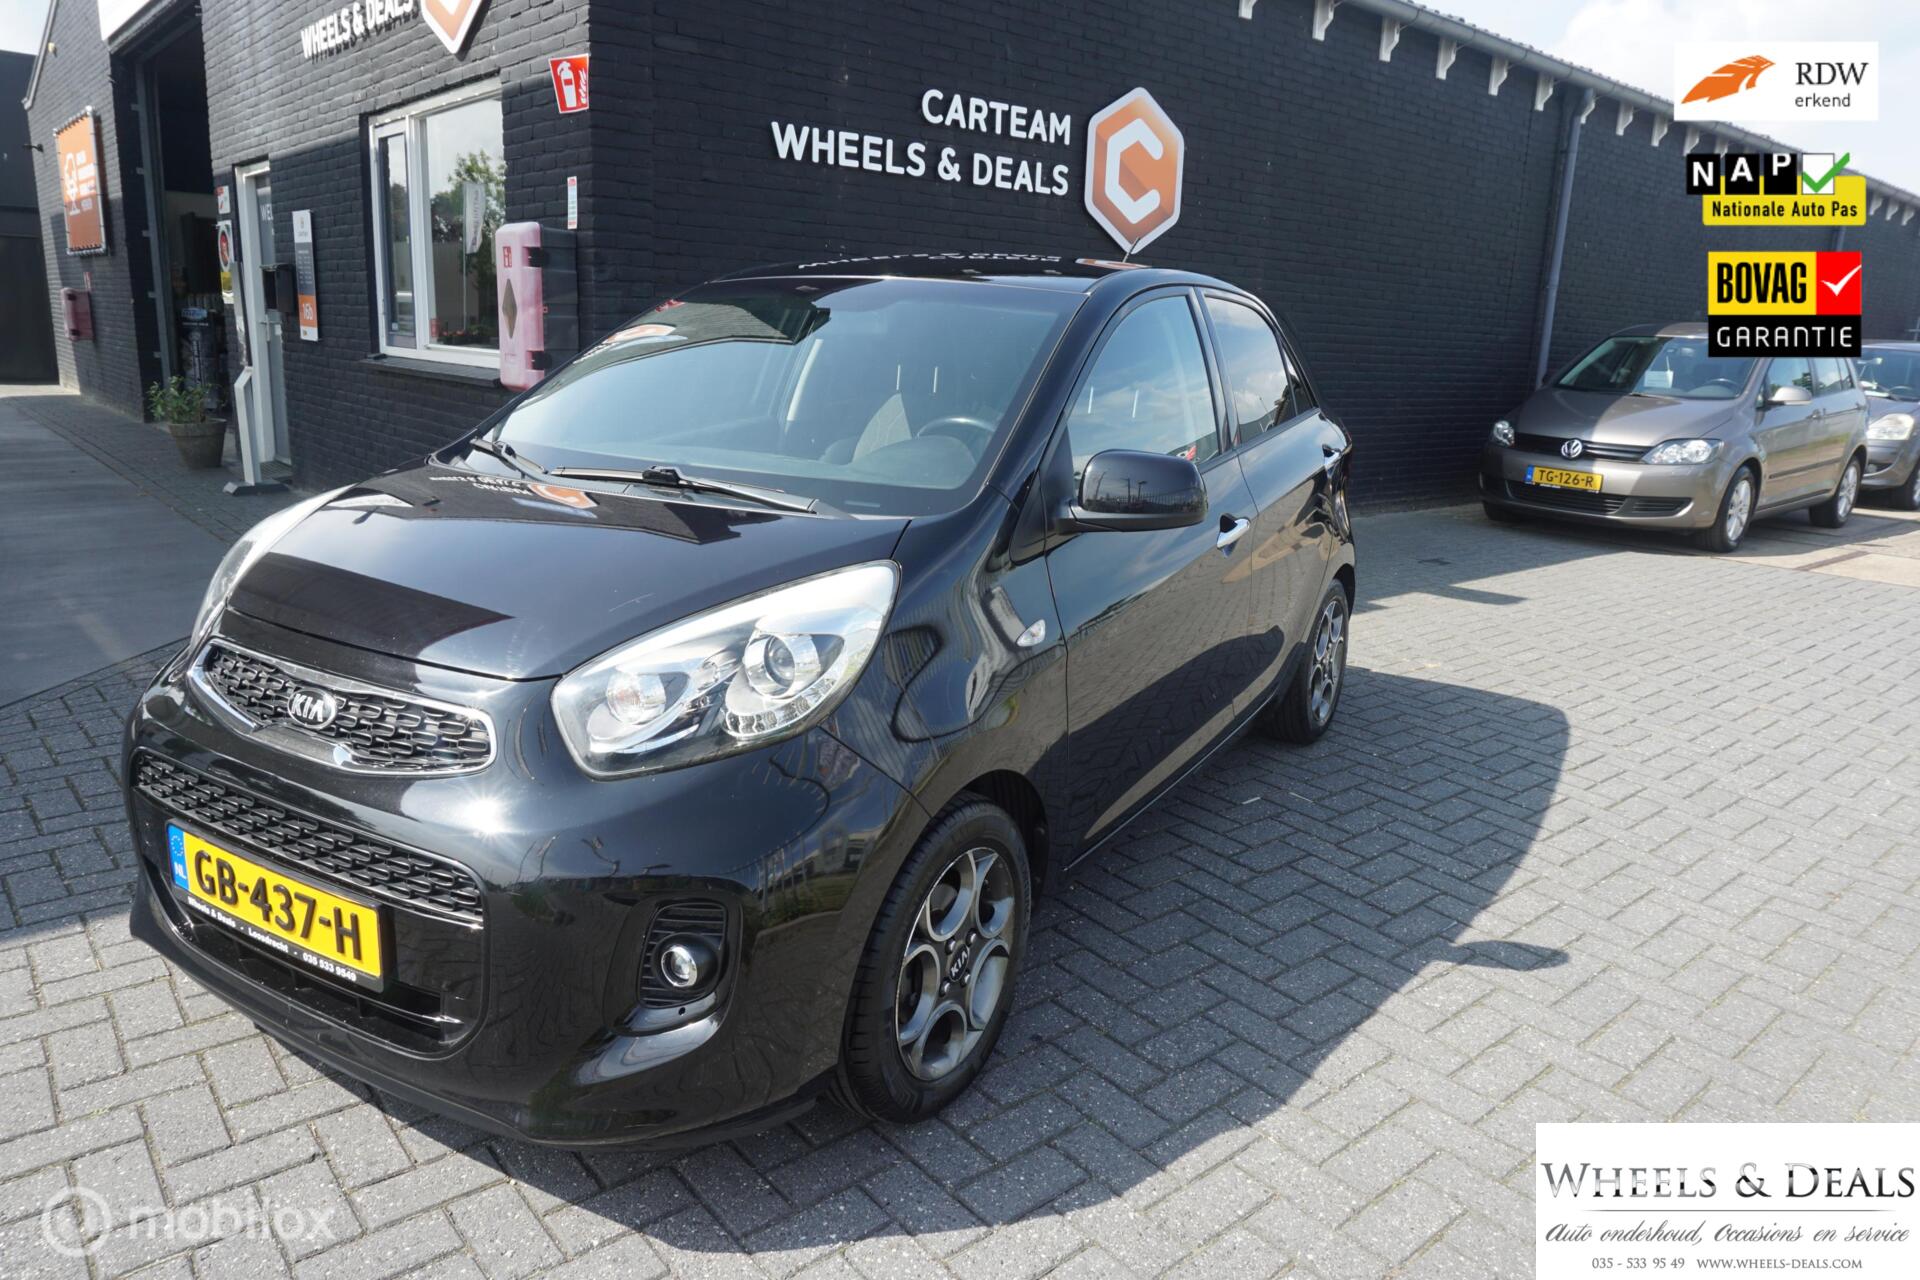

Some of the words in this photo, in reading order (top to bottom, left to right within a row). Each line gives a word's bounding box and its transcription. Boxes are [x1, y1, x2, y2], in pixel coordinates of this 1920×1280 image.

[301, 7, 351, 58] WHEELS
[352, 1, 365, 35] &
[921, 89, 1071, 145] CARTEAM
[771, 121, 926, 177] WHEELS
[938, 147, 961, 182] &
[973, 152, 1069, 196] DEALS
[1539, 469, 1594, 488] TG-126-R
[291, 693, 324, 722] KIA
[174, 861, 187, 880] NL
[194, 850, 362, 961] GB-437-H
[302, 952, 318, 965] 035
[319, 958, 334, 972] 533
[336, 965, 357, 982] 9549
[951, 950, 967, 977] KIA
